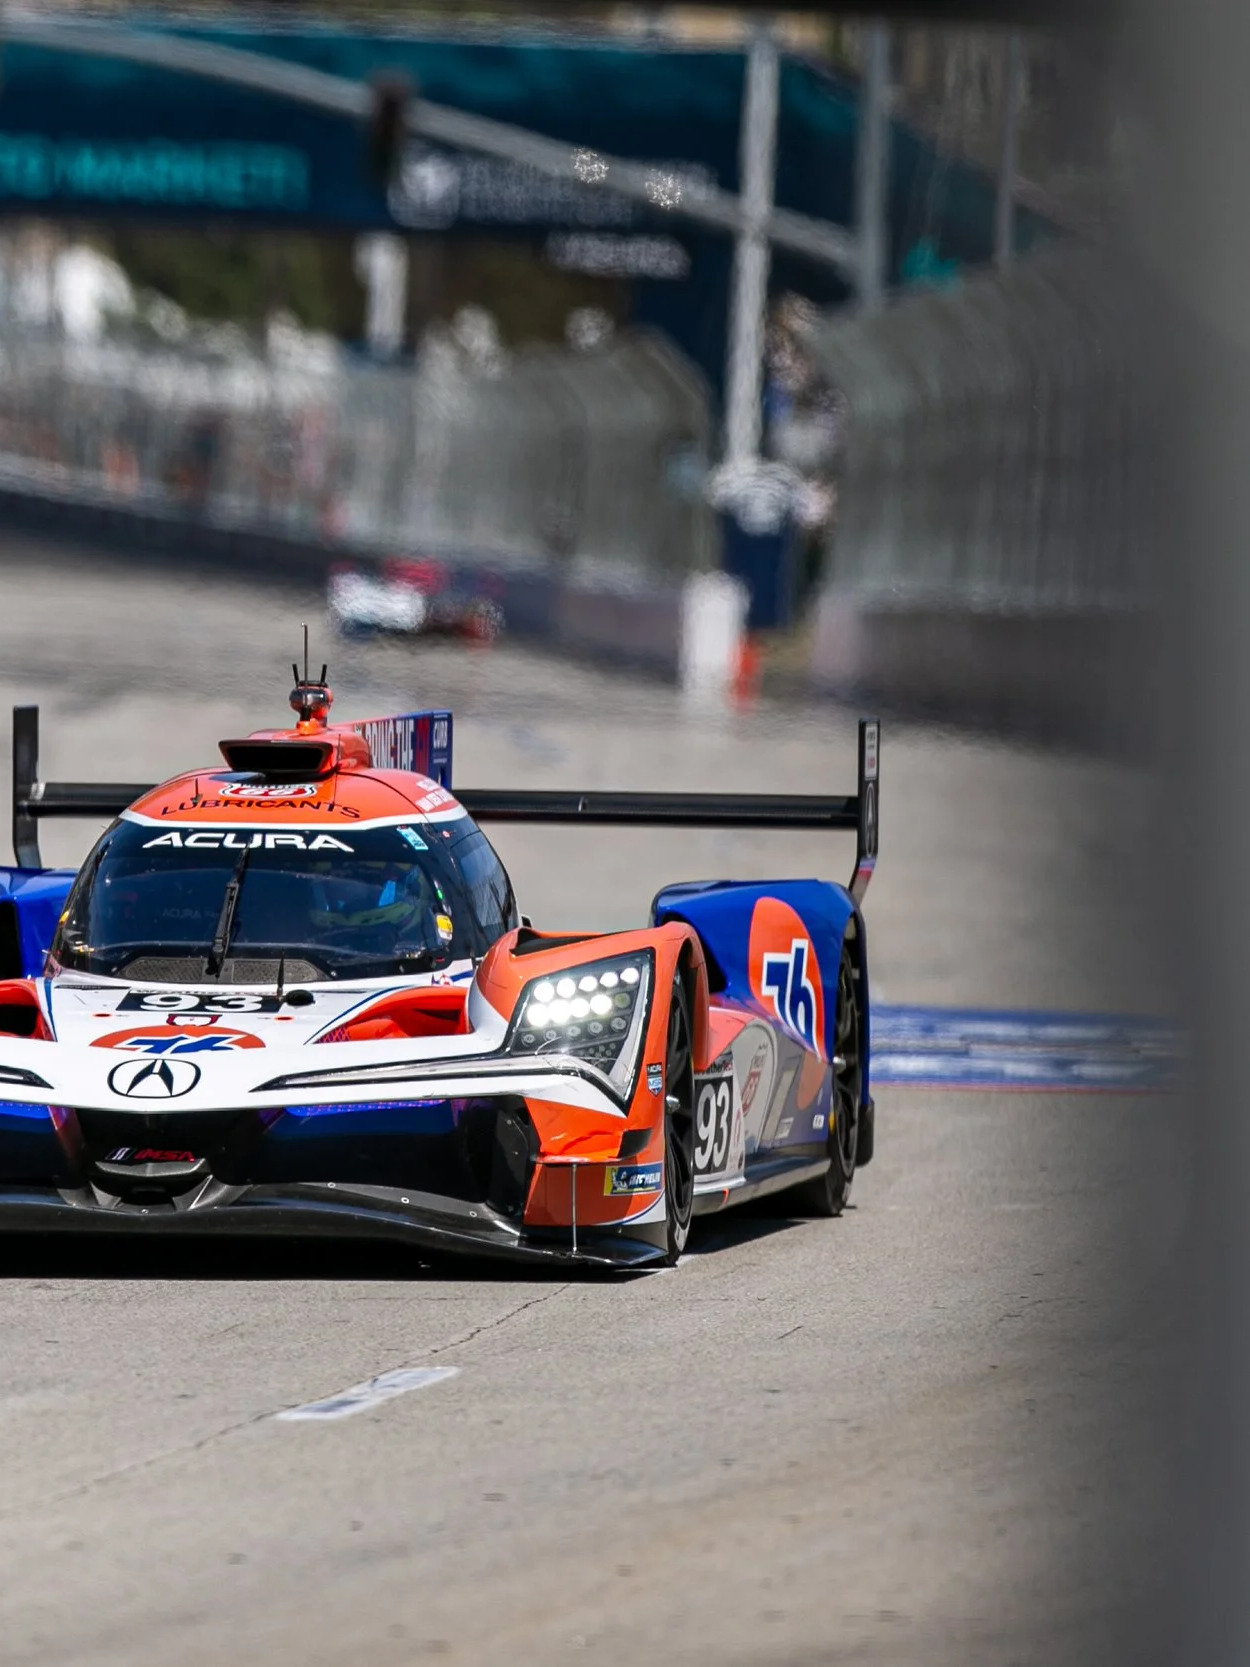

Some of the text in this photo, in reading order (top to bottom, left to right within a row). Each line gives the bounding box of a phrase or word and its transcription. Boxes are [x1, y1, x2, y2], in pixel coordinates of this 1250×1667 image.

[161, 799, 361, 819] LUBRICANTS
[142, 831, 355, 853] ACURA
[140, 993, 263, 1012] 93
[763, 939, 820, 1058] 76
[694, 1081, 730, 1170] 93
